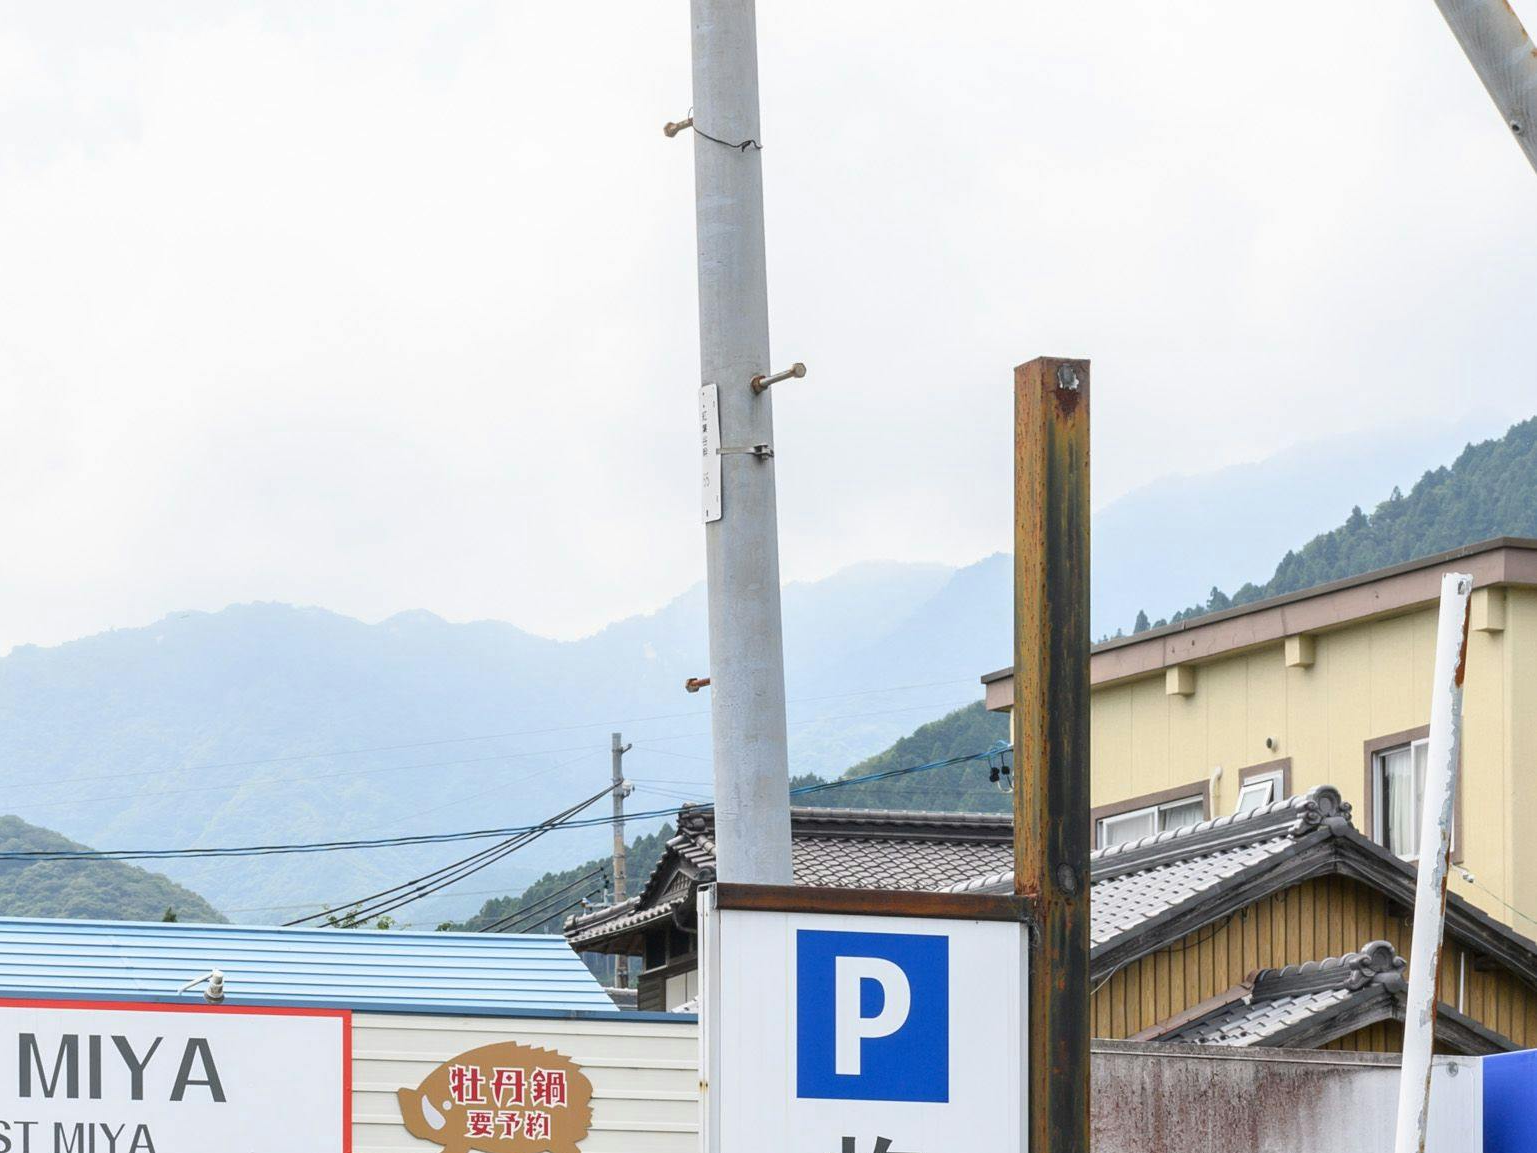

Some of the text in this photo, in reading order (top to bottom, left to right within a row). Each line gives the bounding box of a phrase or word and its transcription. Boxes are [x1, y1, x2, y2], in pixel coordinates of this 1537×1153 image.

[836, 956, 911, 1076] P
[18, 1032, 227, 1103] MIYA
[451, 1067, 566, 1106] 牡丹鍋
[469, 1111, 551, 1138] 要予約
